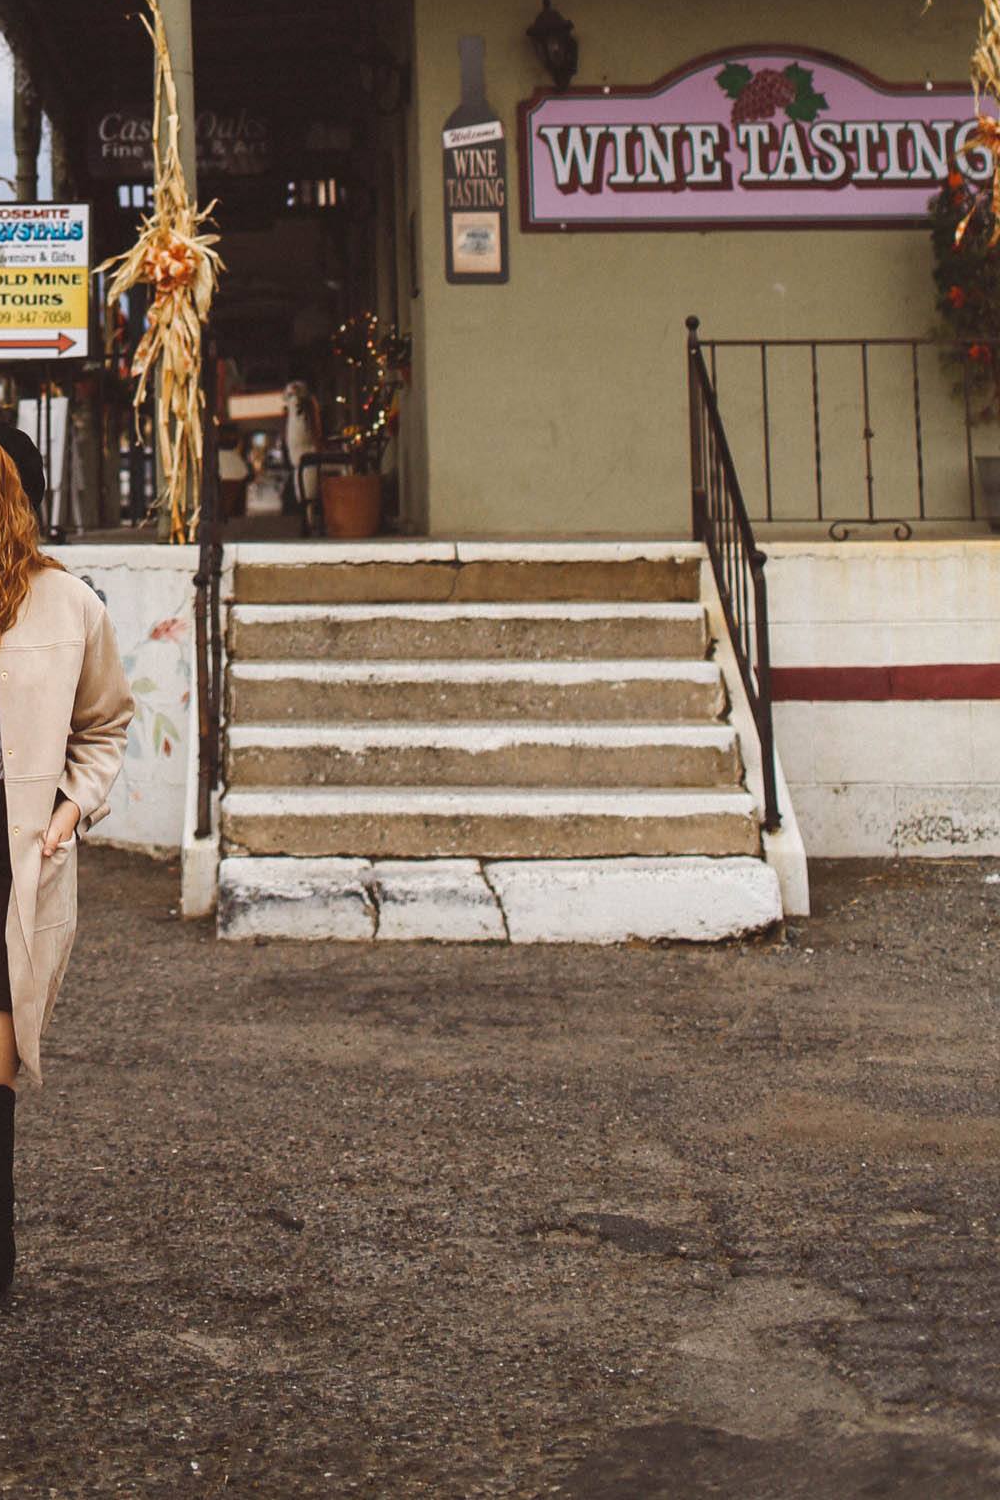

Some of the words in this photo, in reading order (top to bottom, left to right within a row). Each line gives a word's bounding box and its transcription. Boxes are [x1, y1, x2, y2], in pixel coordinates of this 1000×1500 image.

[101, 142, 145, 158] Fine
[453, 148, 498, 178] WINE
[538, 123, 728, 190] WINE
[735, 119, 995, 190] TASTING
[447, 178, 505, 207] TASTING
[33, 272, 82, 286] MINE
